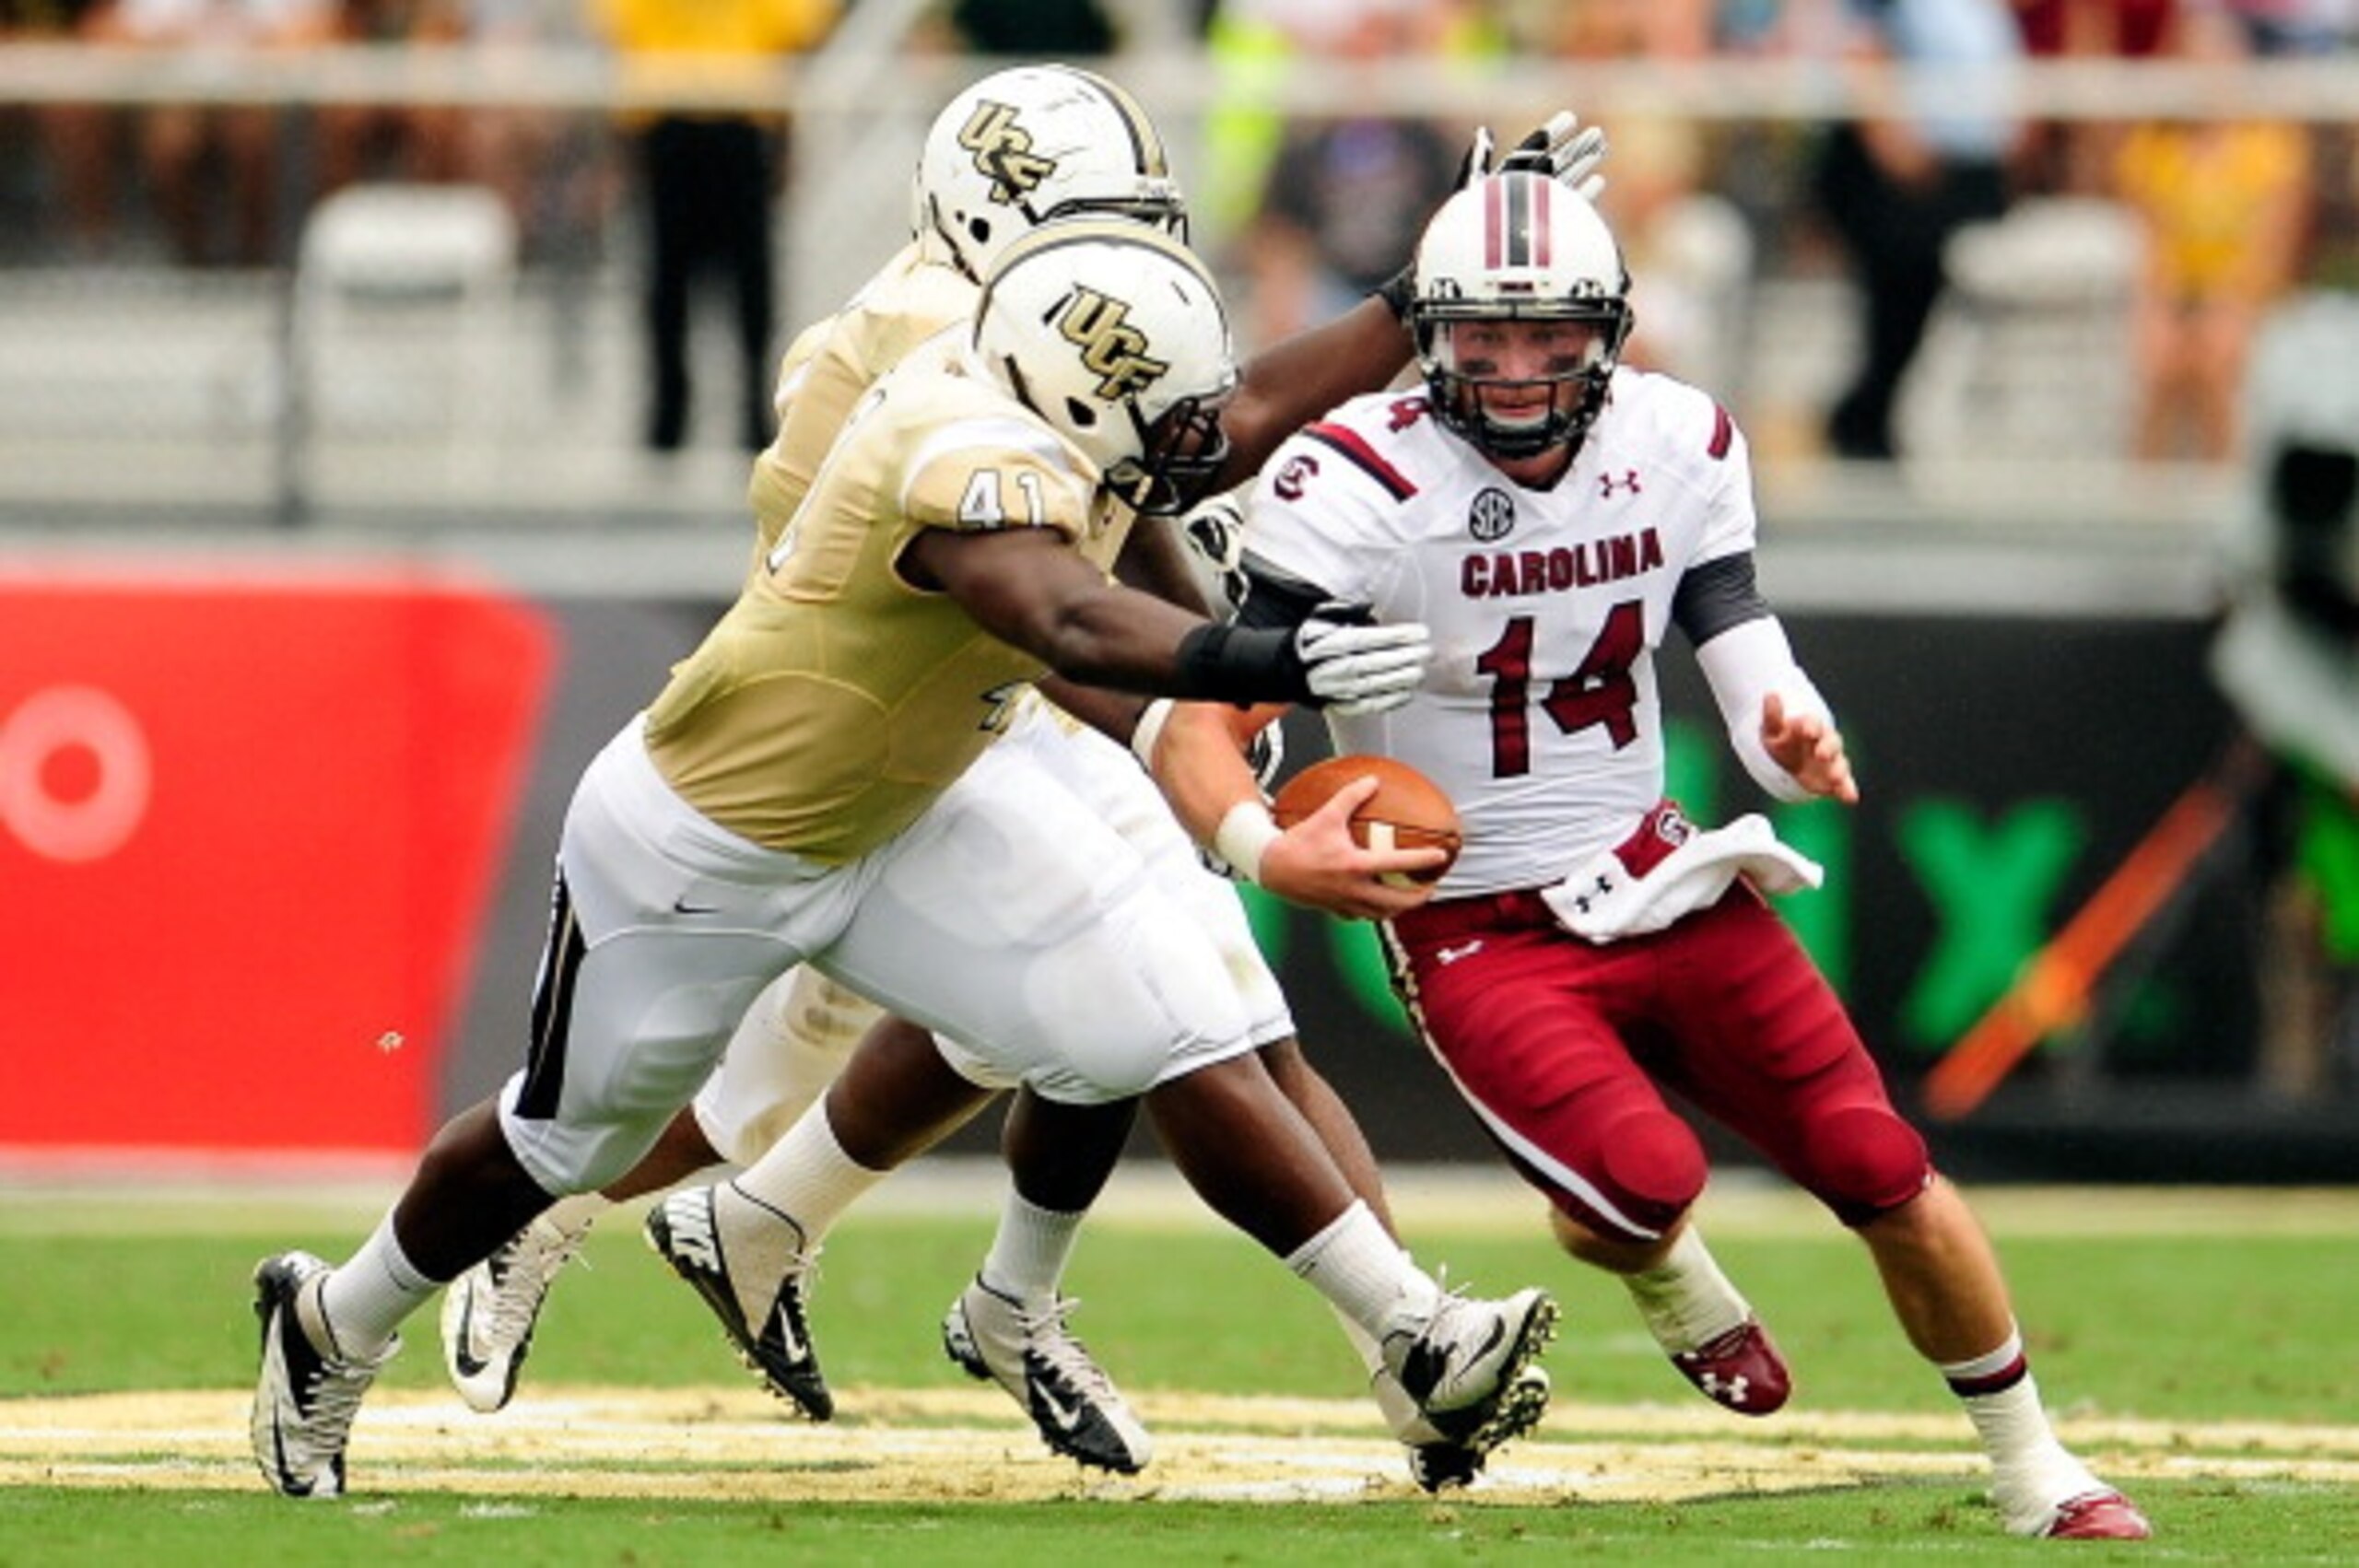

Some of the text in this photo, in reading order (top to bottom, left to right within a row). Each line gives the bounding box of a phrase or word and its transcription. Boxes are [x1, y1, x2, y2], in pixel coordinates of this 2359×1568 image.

[957, 99, 1057, 205] UCF
[1058, 281, 1171, 401] UCF
[957, 468, 1045, 530] 41
[1461, 527, 1664, 599] CAROLINA
[1475, 599, 1645, 779] 14
